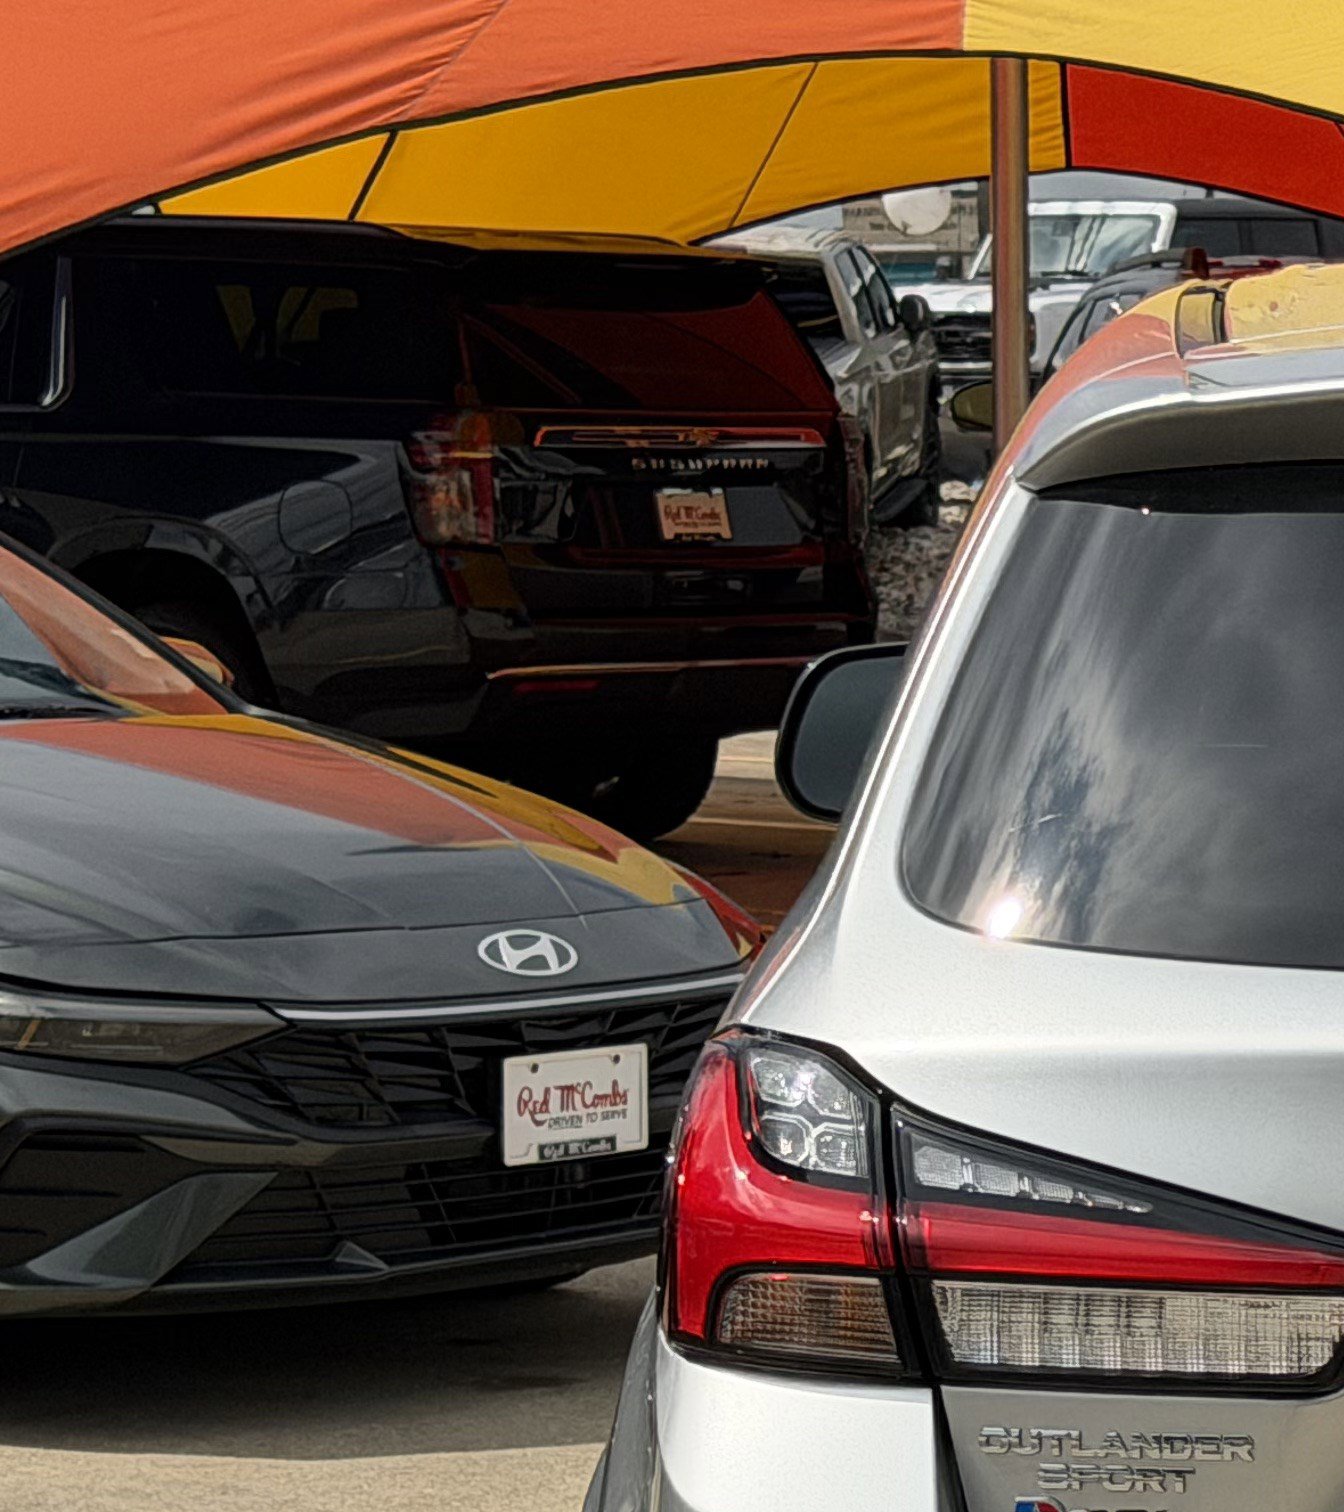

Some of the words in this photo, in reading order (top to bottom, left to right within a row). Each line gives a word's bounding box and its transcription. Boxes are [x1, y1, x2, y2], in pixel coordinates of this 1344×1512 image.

[517, 1085, 551, 1127] Red
[553, 1079, 628, 1112] McCombs
[548, 1114, 583, 1128] DRIVEN
[586, 1112, 598, 1124] TO
[978, 1426, 1256, 1463] OUTLANDER
[1036, 1463, 1196, 1494] SPORT
